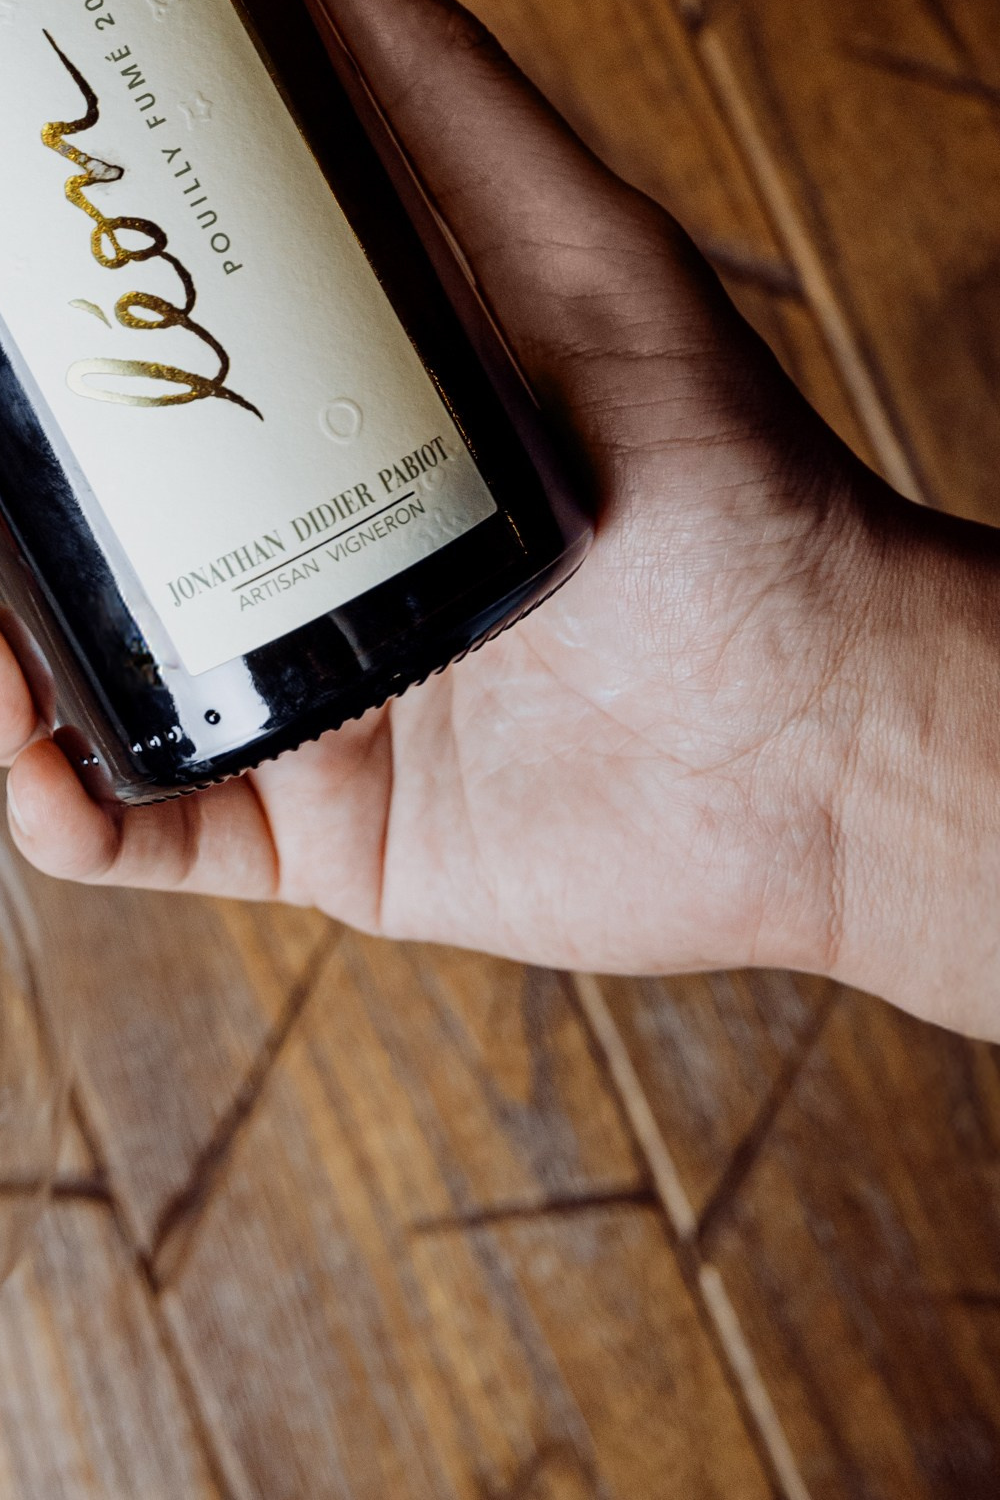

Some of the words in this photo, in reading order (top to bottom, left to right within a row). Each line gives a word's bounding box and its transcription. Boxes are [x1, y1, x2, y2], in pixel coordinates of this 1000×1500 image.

[105, 44, 167, 130] FUMÉ
[162, 147, 243, 275] POUILLY
[166, 530, 287, 607] JONATHAN
[290, 482, 376, 543] DIDIER
[377, 435, 449, 493] PABIOT
[239, 557, 321, 612] ARTISAN
[325, 498, 426, 562] VIGNERON
